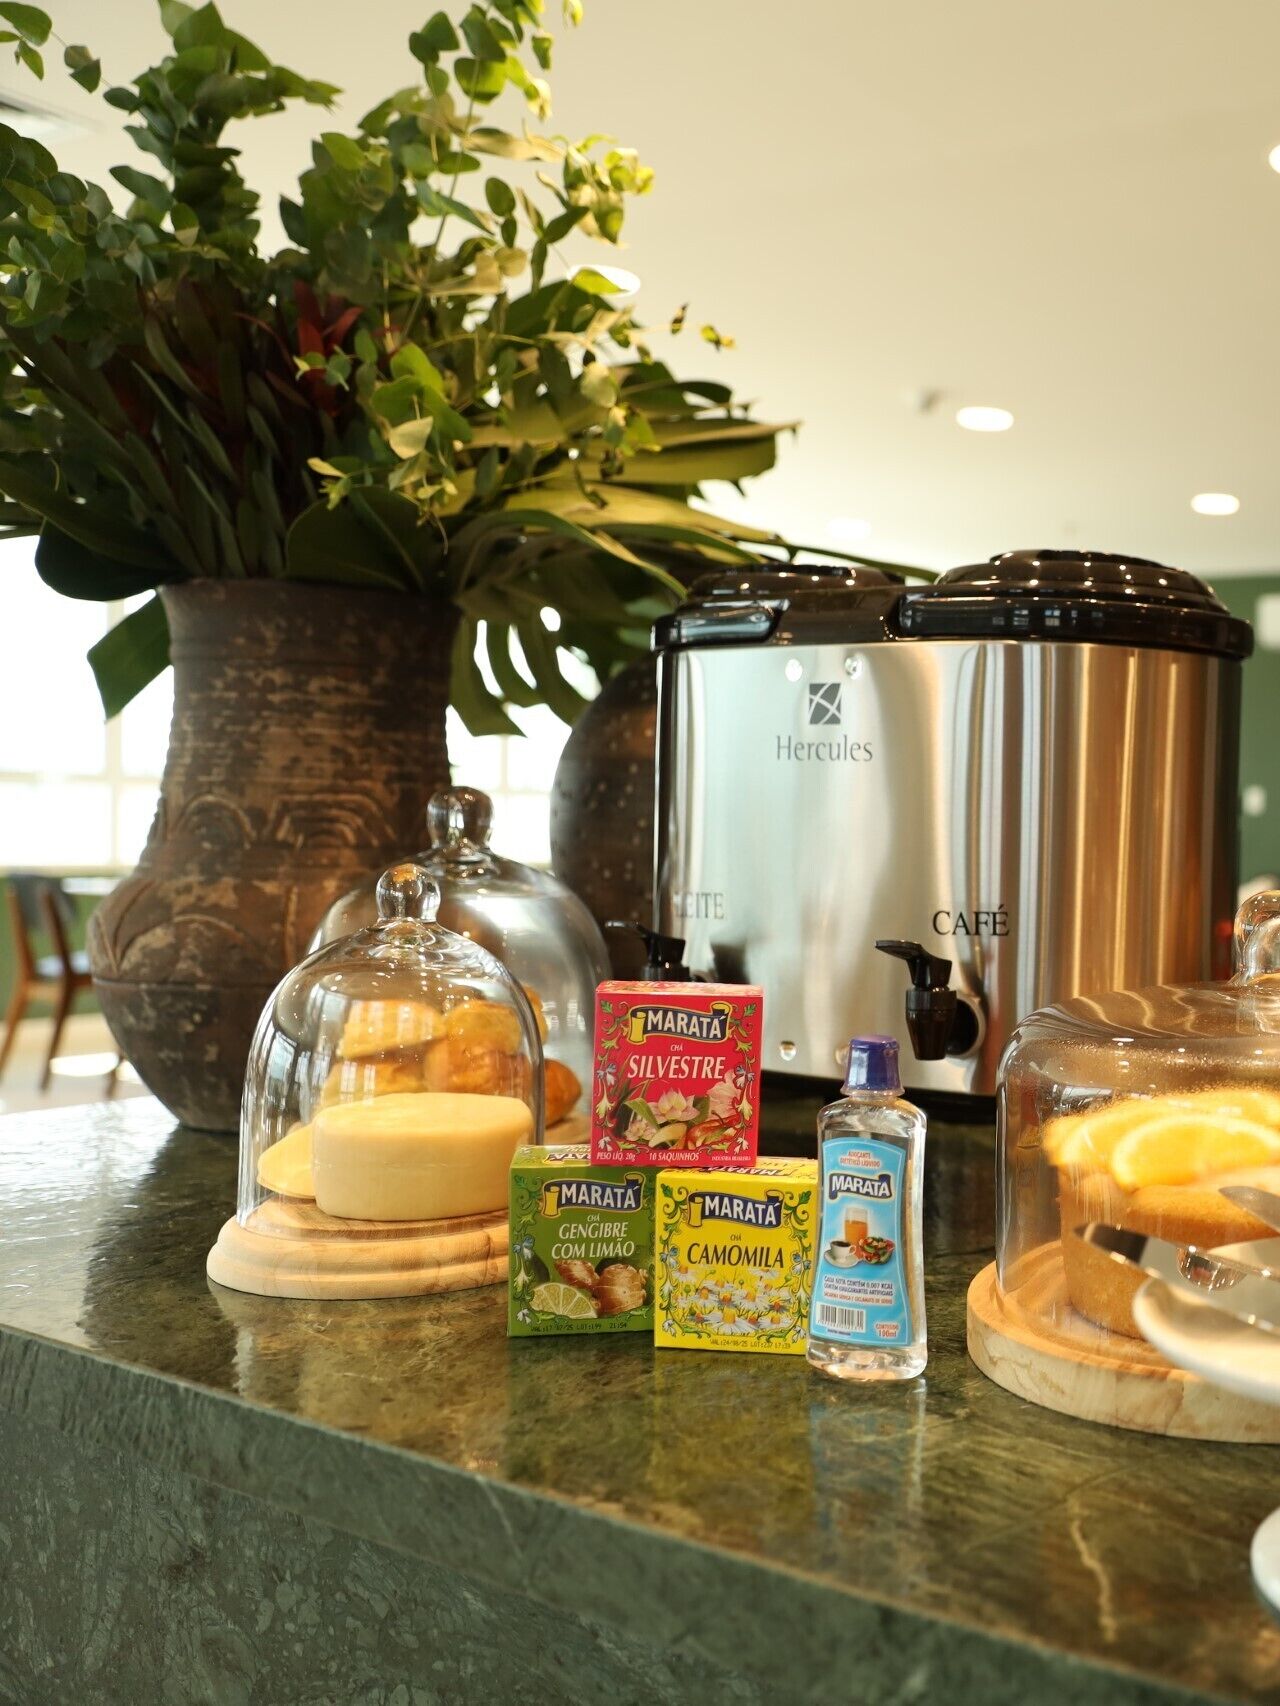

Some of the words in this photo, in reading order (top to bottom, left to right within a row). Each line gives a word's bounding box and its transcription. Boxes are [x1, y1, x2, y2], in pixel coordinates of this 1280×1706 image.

[776, 734, 873, 762] Hercules
[932, 904, 1010, 937] CAFÉ
[647, 1009, 726, 1039] MARATÁ
[670, 1043, 683, 1052] CHÁ
[627, 1054, 726, 1079] SILVESTRE
[596, 1152, 612, 1160] PESO
[649, 1152, 657, 1160] 10
[658, 1152, 700, 1163] SAQUINHOS
[561, 1183, 640, 1209] MARATÁ
[587, 1213, 600, 1222] CHÁ
[704, 1195, 780, 1225] MARATÁ
[558, 1222, 629, 1239] GENGIBRE
[730, 1234, 742, 1242] CHÁ
[551, 1242, 586, 1259] COM
[589, 1238, 635, 1258] LIMÃO
[687, 1242, 784, 1268] CAMOMILA
